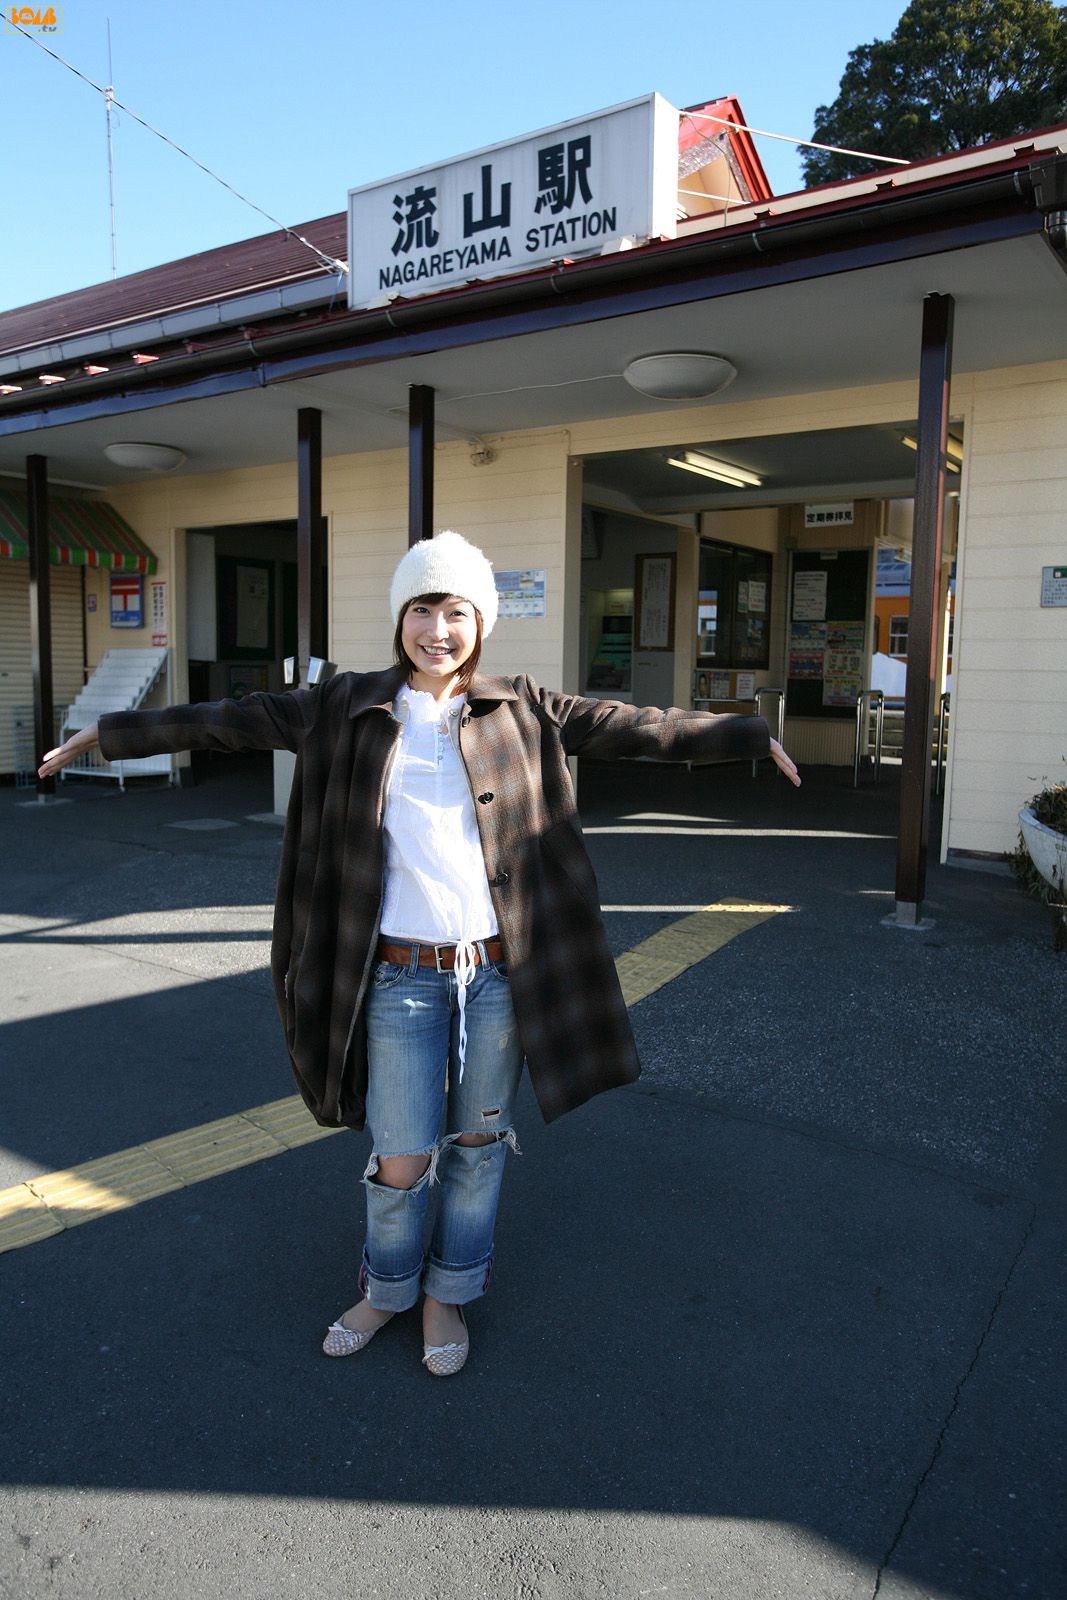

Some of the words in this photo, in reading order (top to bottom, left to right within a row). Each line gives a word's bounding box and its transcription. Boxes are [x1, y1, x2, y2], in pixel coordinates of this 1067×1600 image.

[391, 134, 594, 257] 流山駅
[379, 236, 511, 290] NAGAREYAMA
[525, 206, 617, 253] STATION
[806, 511, 853, 523] 定期券拝見
